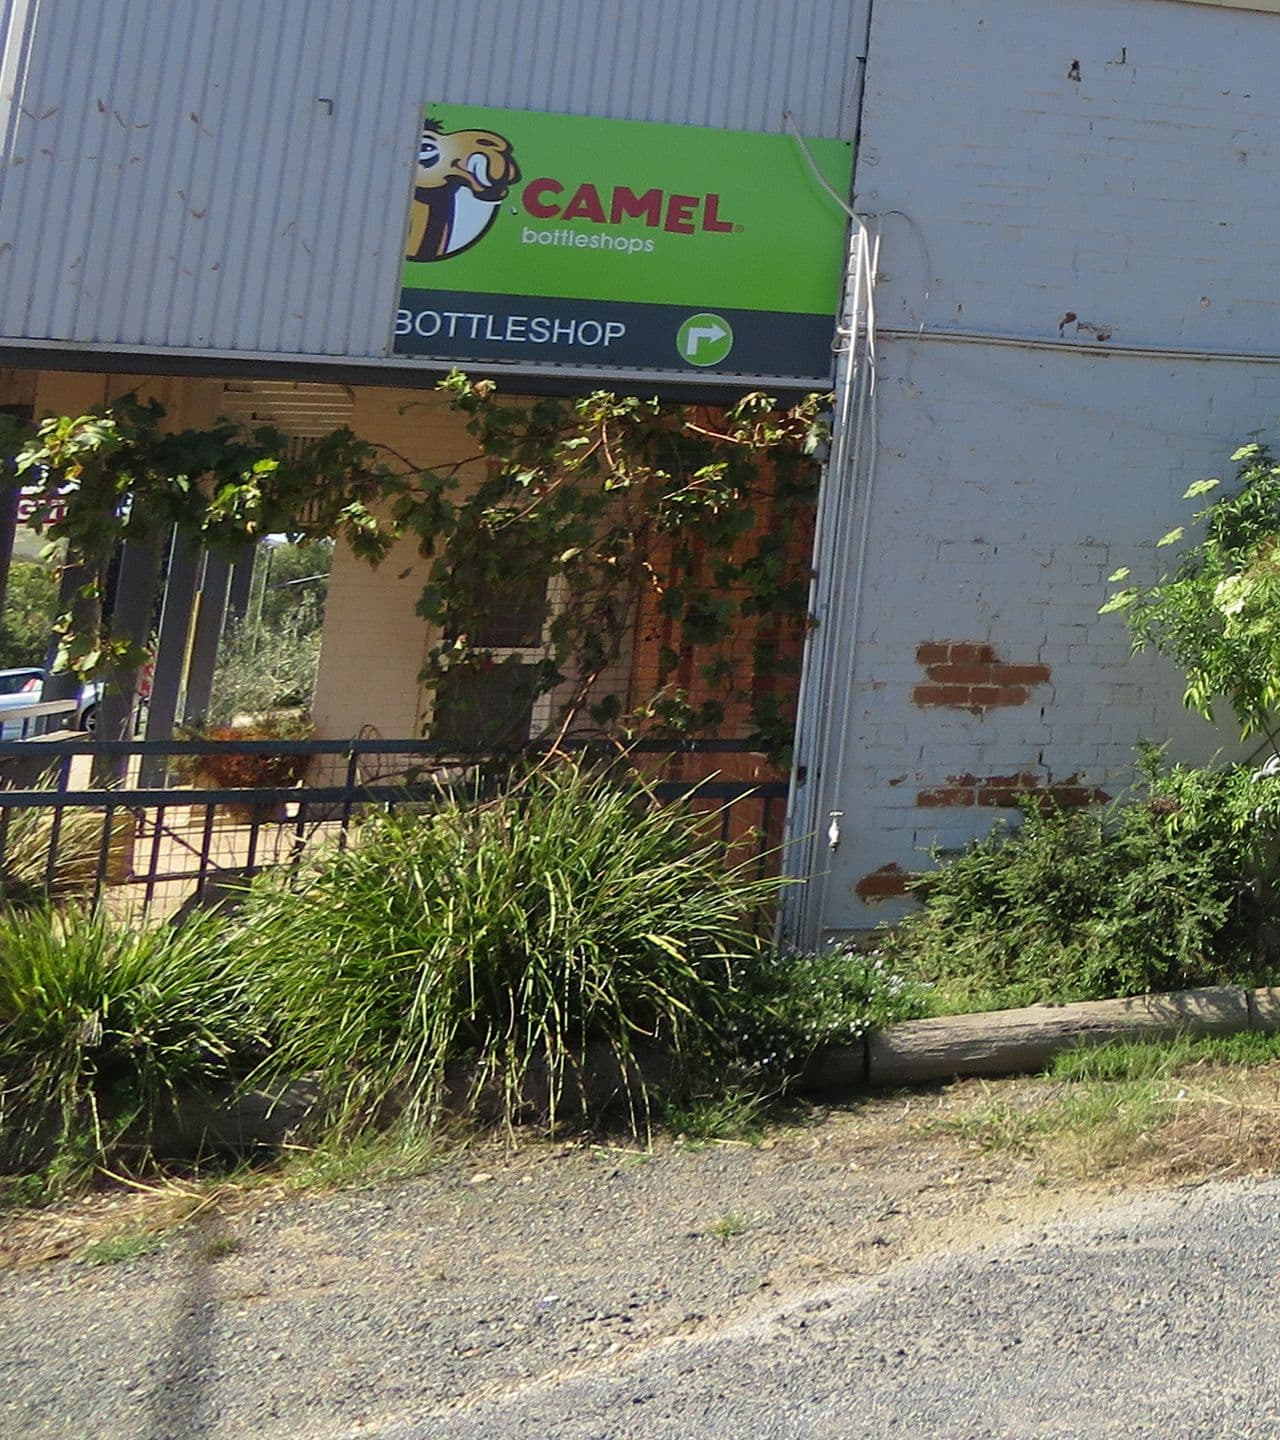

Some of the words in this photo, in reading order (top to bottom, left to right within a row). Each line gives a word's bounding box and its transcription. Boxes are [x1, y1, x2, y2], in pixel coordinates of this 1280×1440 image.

[522, 177, 733, 235] CAMEL
[521, 227, 655, 255] bottleshops
[393, 309, 626, 347] BOTTLESHOP
